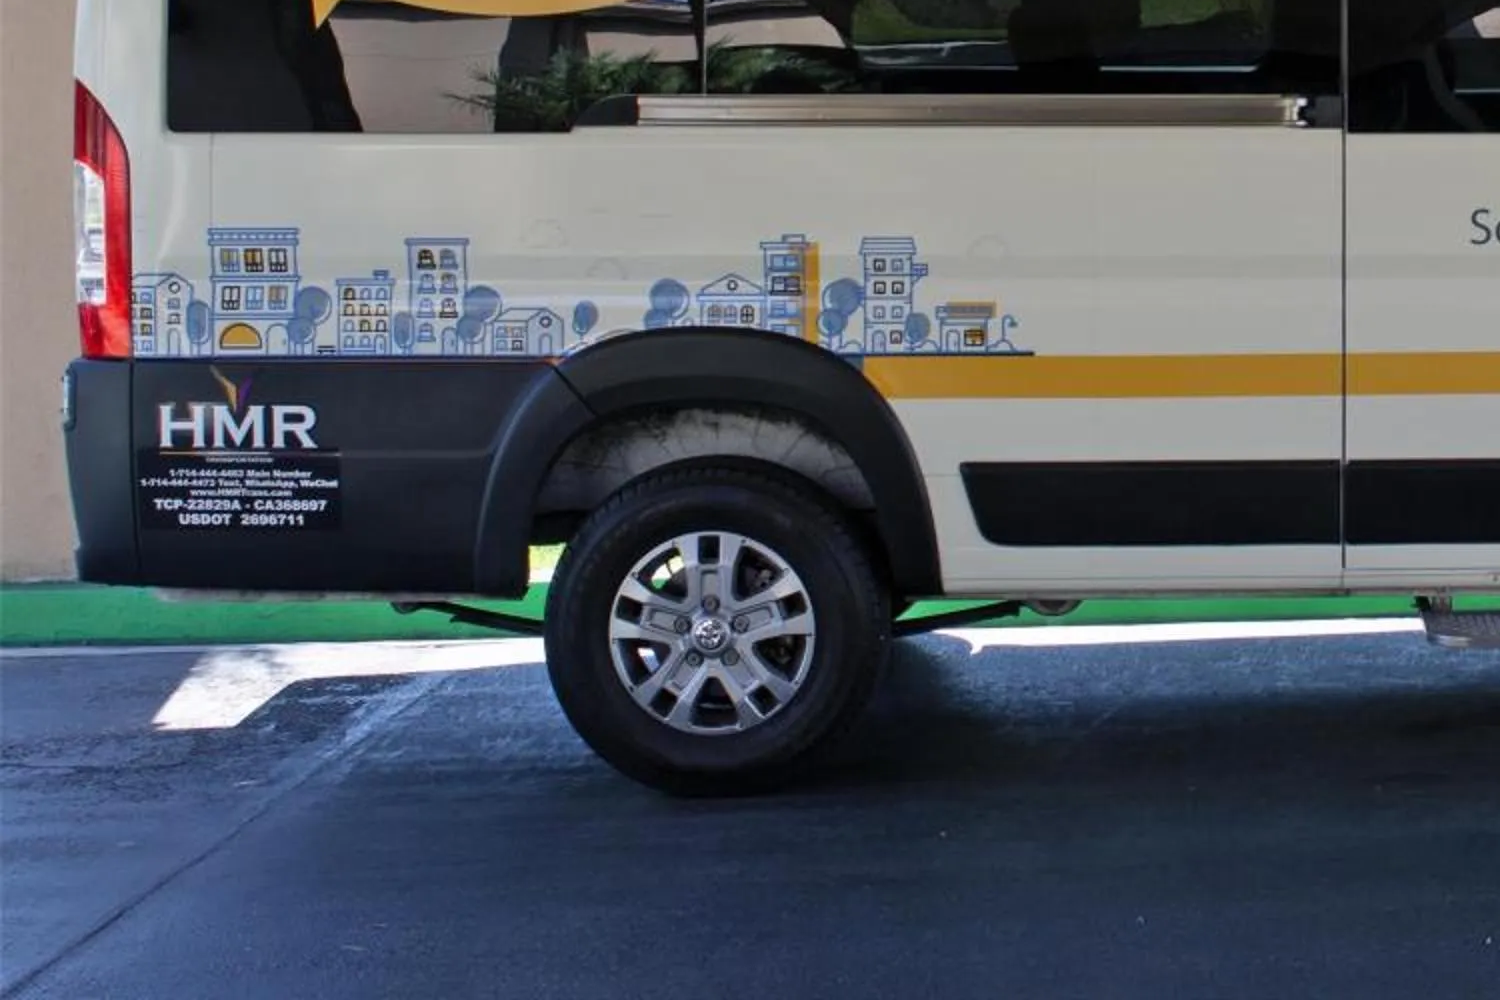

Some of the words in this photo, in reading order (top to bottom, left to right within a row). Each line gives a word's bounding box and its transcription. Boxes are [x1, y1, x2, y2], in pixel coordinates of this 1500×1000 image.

[158, 403, 319, 449] HMR
[246, 469, 271, 478] Main
[273, 469, 312, 478] Number
[178, 513, 231, 525] USDOT
